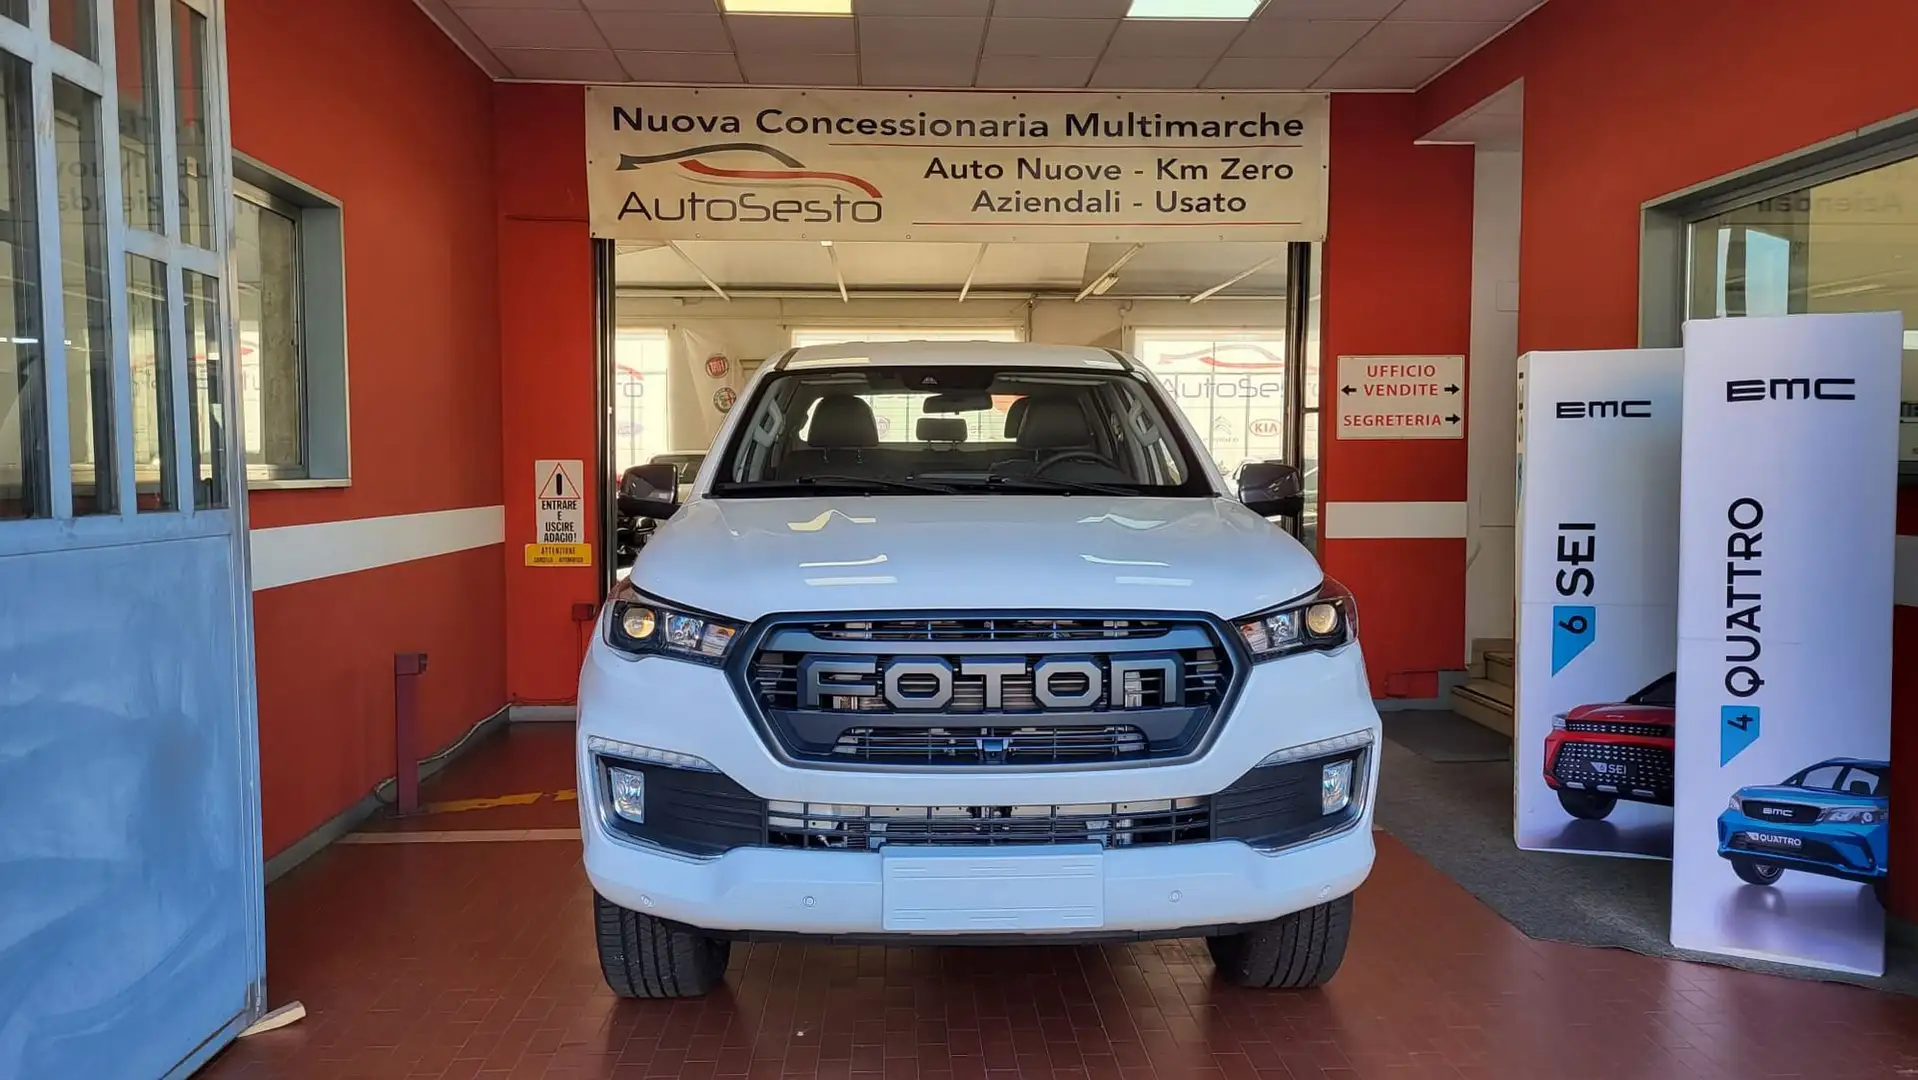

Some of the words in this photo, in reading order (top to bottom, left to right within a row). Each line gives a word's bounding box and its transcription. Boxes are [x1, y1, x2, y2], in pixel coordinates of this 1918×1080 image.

[613, 107, 740, 134] Nuova
[756, 109, 1049, 138] Concessionaria
[1065, 112, 1304, 138] Multimarche
[924, 157, 1004, 180] Auto
[1017, 158, 1122, 180] Nuove
[1157, 158, 1208, 180] Km
[1220, 158, 1294, 180] Zero
[617, 191, 883, 223] AutoSesto
[971, 190, 1121, 213] Aziendali
[1156, 191, 1247, 213] Usato
[1366, 364, 1436, 378] UFFICIO
[1363, 384, 1439, 396] VENDITE
[1727, 378, 1856, 402] EMC
[1556, 400, 1652, 418] EMC
[1254, 422, 1278, 434] KIA
[1343, 414, 1442, 426] SEGRETERIA
[541, 500, 577, 510] ENTRARE
[557, 511, 563, 521] E
[545, 522, 575, 532] USCIRE
[544, 532, 577, 543] ADAGIO!
[1555, 522, 1596, 597] SEI
[1725, 497, 1765, 698] QUATTRO
[1558, 614, 1588, 635] 6
[1727, 713, 1754, 731] 4
[1608, 763, 1627, 775] SEI
[1759, 834, 1802, 847] QUATTRO
